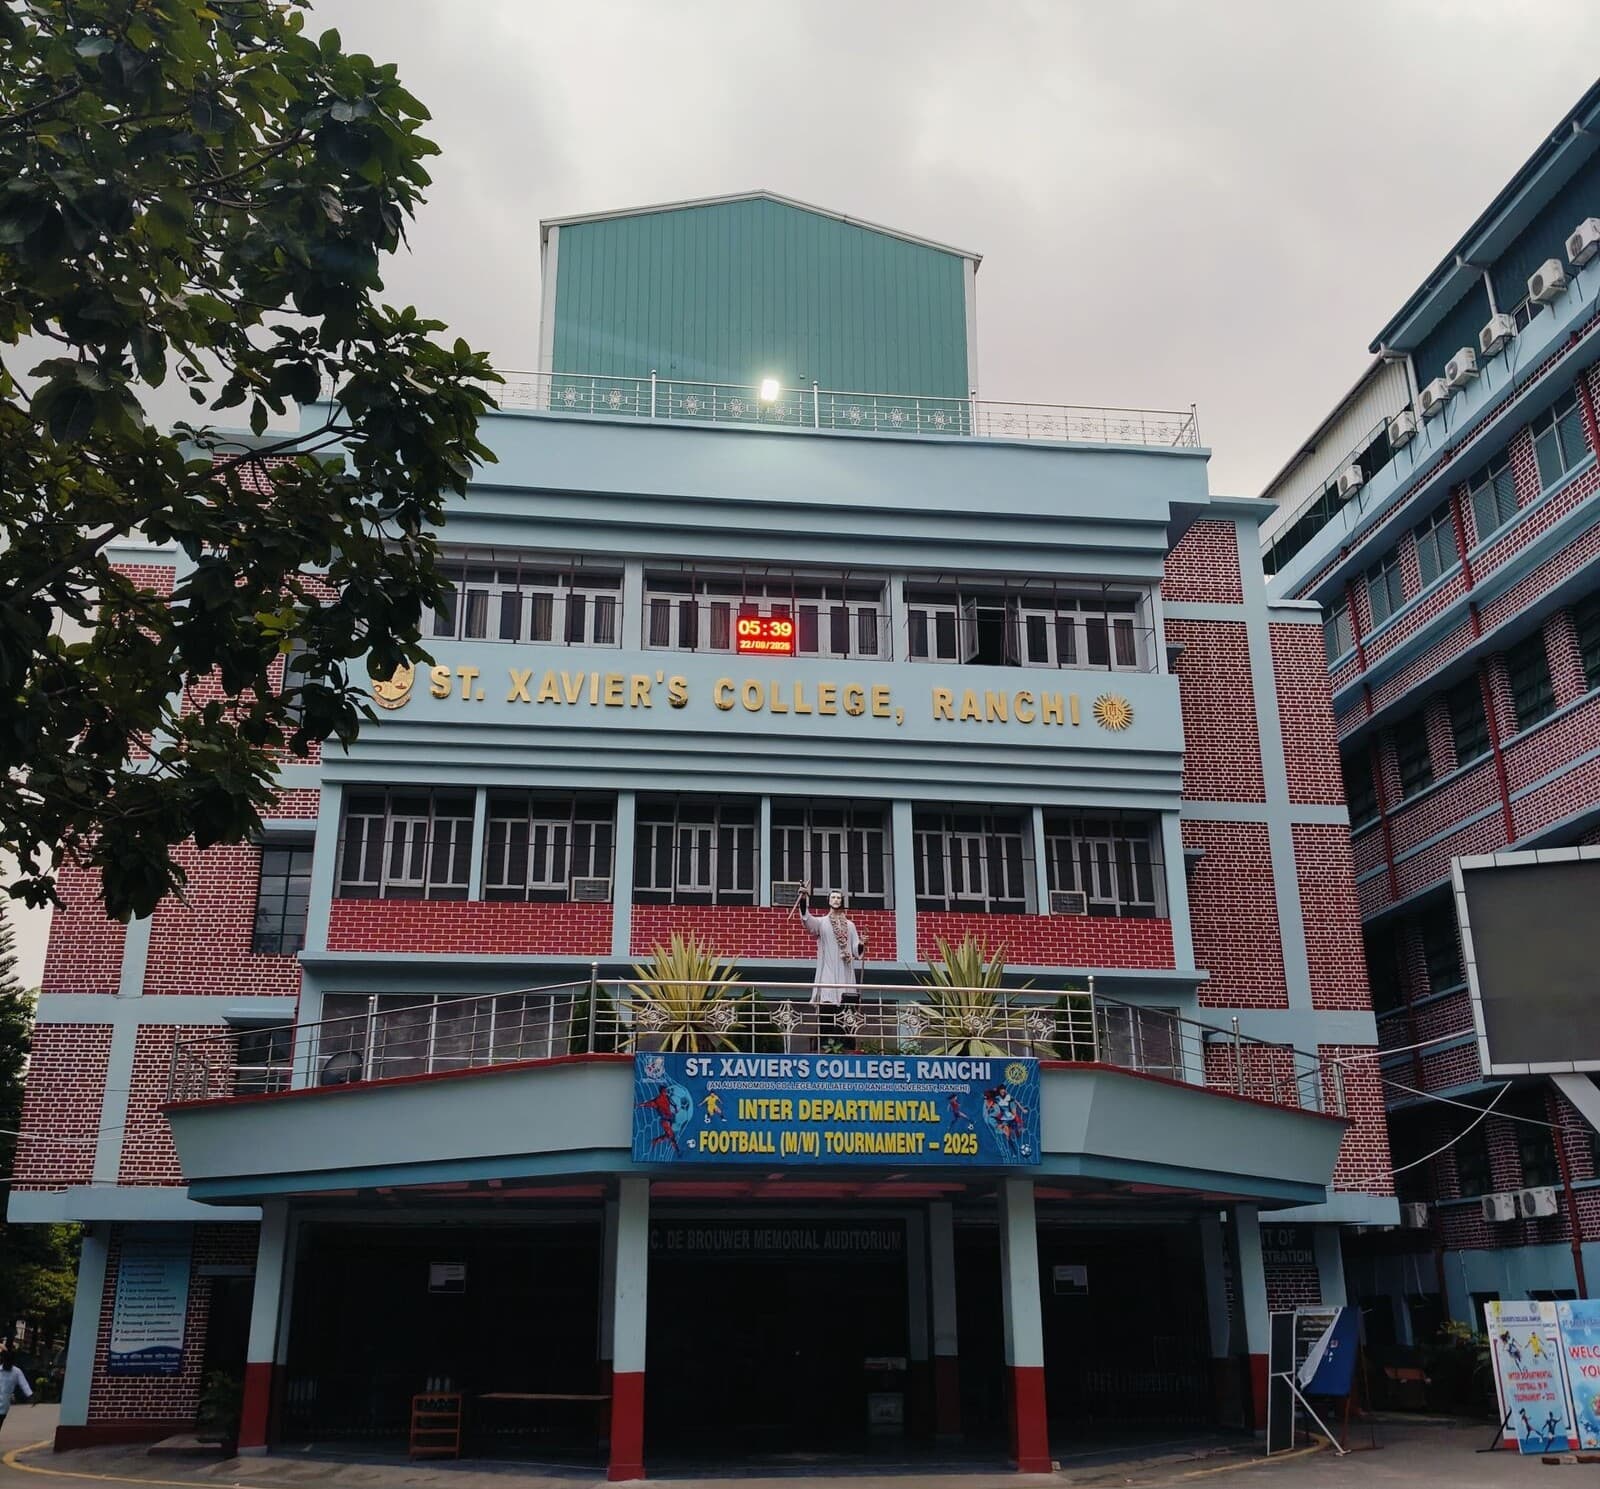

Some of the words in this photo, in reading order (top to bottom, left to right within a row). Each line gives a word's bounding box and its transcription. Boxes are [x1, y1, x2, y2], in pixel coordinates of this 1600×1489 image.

[738, 619, 792, 638] 05:39
[431, 668, 485, 700] ST.
[507, 669, 689, 707] XAVIER'S
[713, 679, 904, 725] COLLEGE,
[932, 687, 1081, 725] RANCHI
[685, 1058, 714, 1077] ST.
[720, 1058, 810, 1078] XAVIER'S
[816, 1060, 911, 1083] COLLEGE,
[917, 1061, 991, 1081] RANCHI
[722, 1080, 775, 1091] AUTONOMOUS
[776, 1081, 810, 1091] COLLEGE
[811, 1081, 852, 1091] AFFILIATED
[853, 1082, 864, 1091] TO
[865, 1082, 892, 1092] RANCHI
[738, 1099, 792, 1121] INTER
[799, 1099, 940, 1122] DEPARTMENTAL
[699, 1131, 775, 1154] FOOTBALL
[780, 1132, 820, 1157] (M/W)
[825, 1132, 925, 1154] TOURNAMENT
[943, 1134, 978, 1155] 2025
[666, 1231, 685, 1248] DE
[687, 1230, 750, 1248] BROUWER
[752, 1230, 820, 1248] MEMORIAL
[823, 1230, 904, 1248] AUDITORIUM
